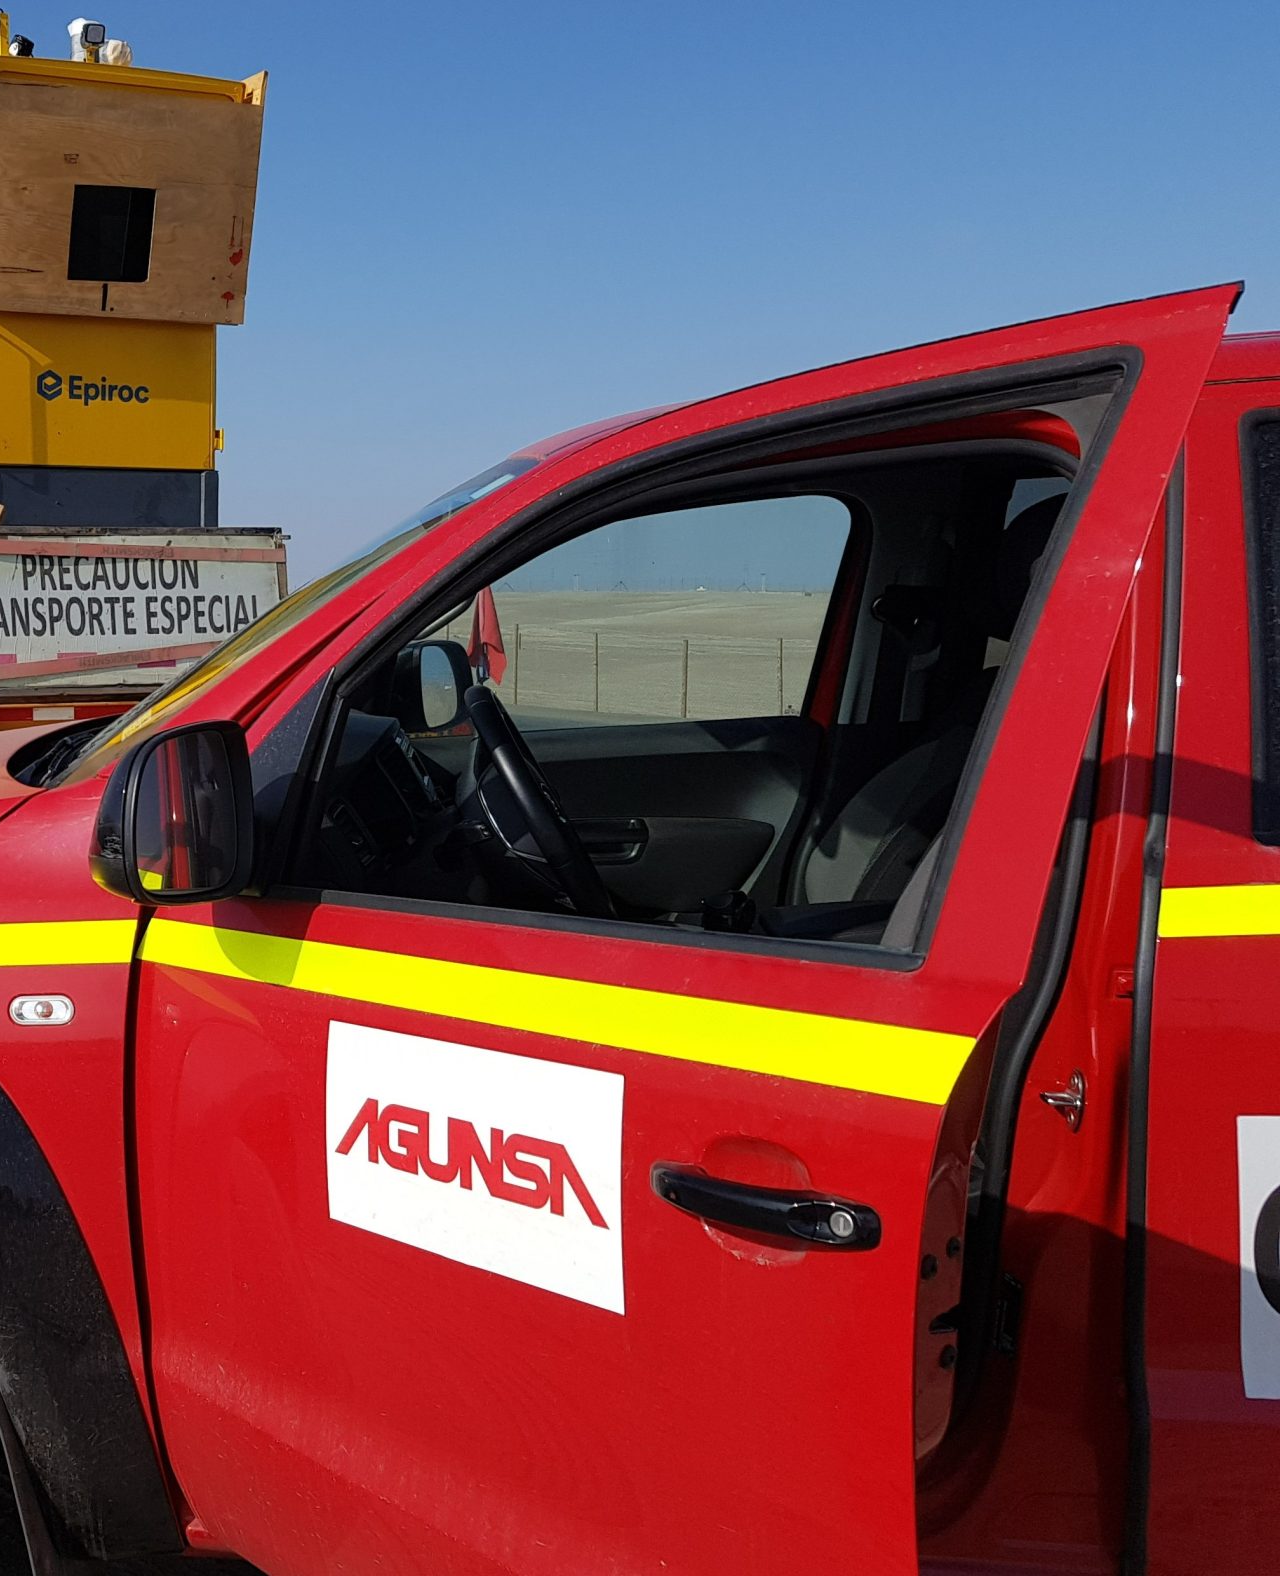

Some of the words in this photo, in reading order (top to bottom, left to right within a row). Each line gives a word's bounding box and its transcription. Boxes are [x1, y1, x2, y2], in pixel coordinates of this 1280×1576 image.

[68, 375, 150, 406] Epiroc
[21, 554, 200, 591] PRECAUCION
[334, 1097, 610, 1230] AGUNSA
